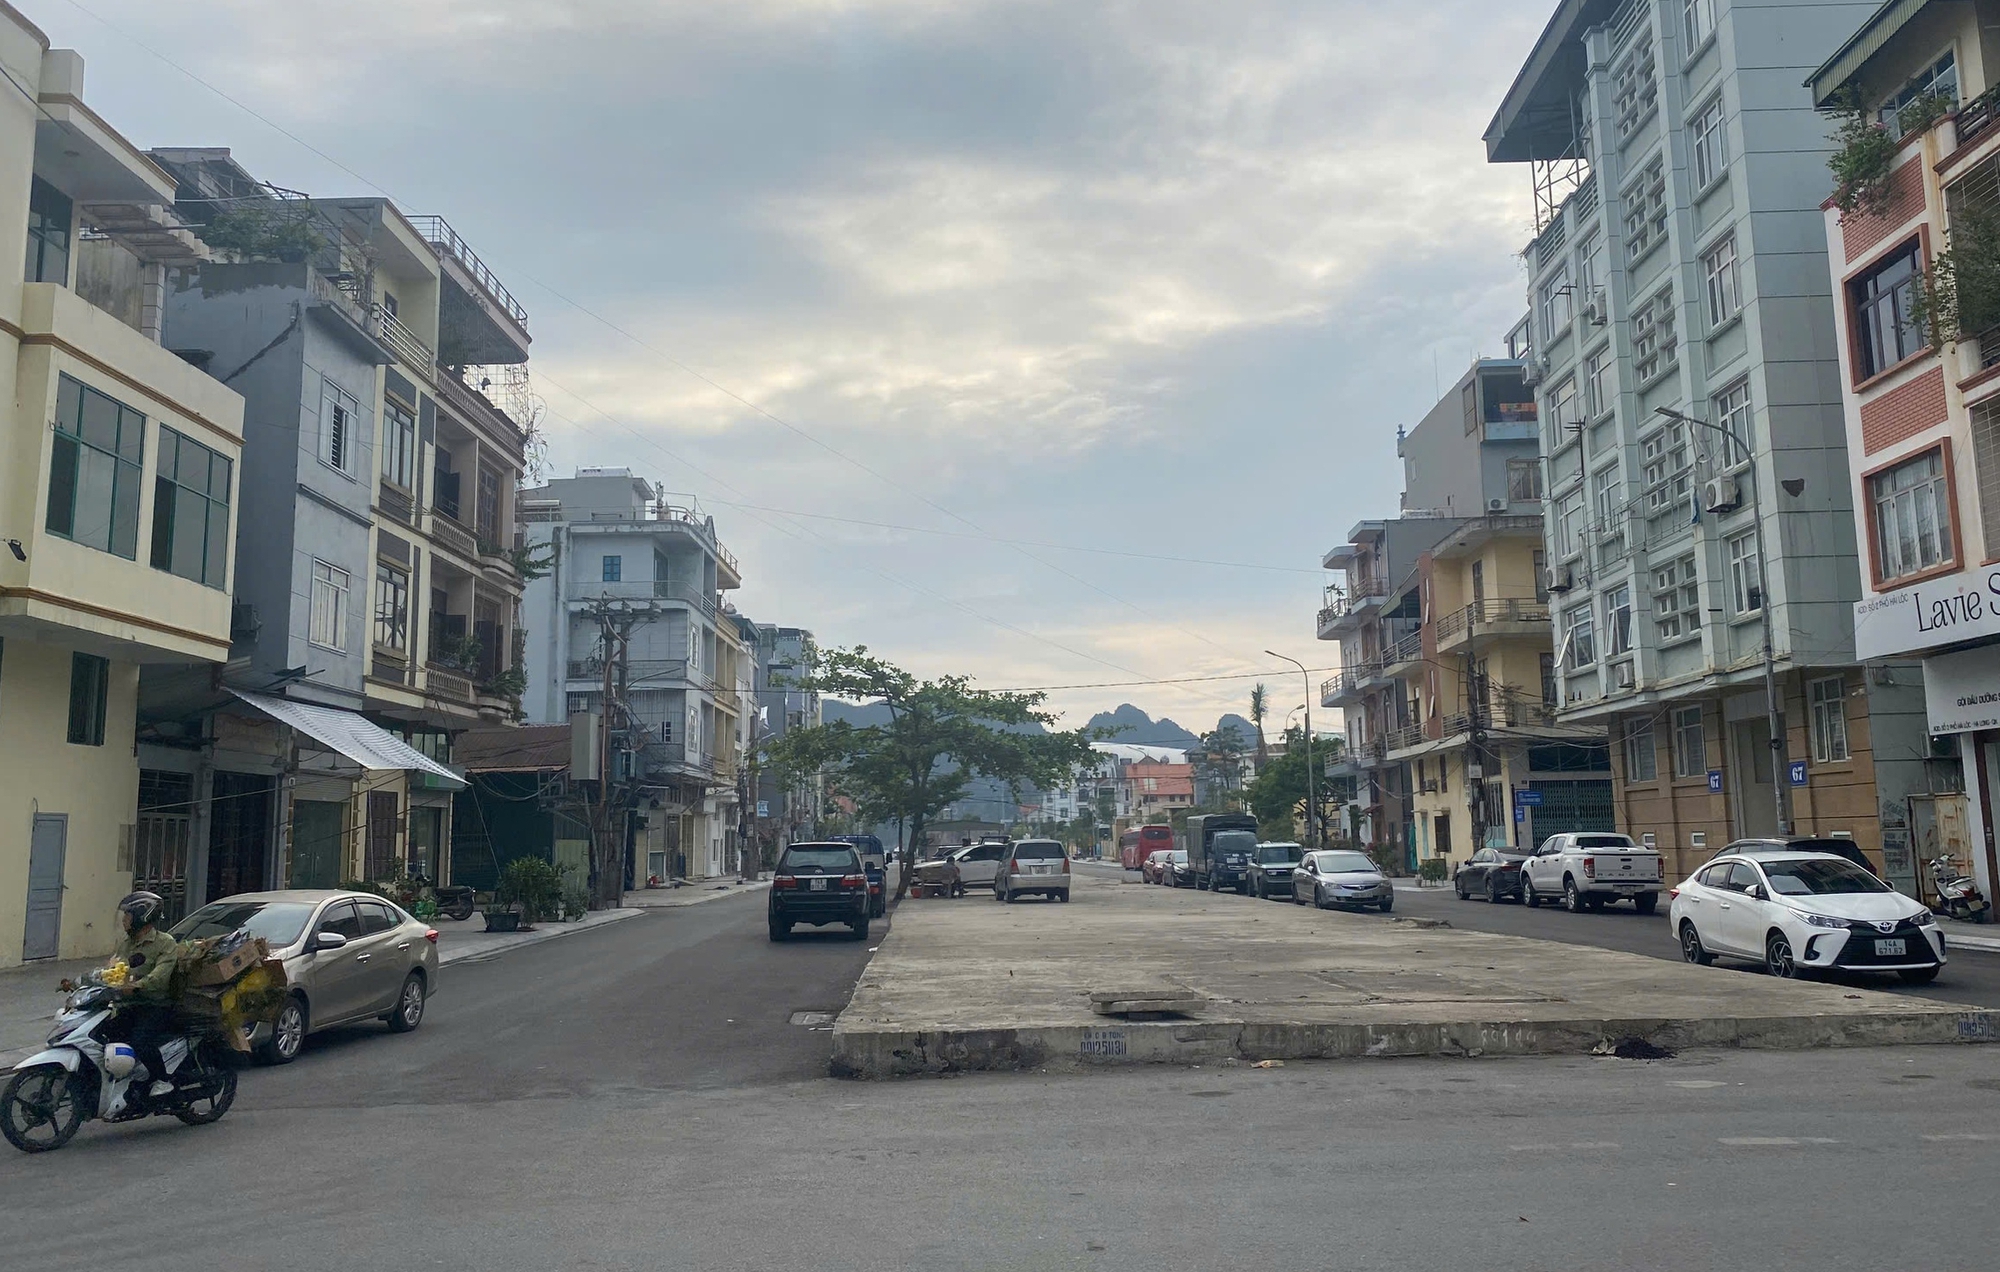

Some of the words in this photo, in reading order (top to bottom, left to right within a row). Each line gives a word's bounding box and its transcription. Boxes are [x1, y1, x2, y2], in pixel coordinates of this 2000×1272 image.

[1913, 587, 1982, 632] Lavie
[1710, 775, 1720, 789] 67
[1792, 766, 1803, 782] 67
